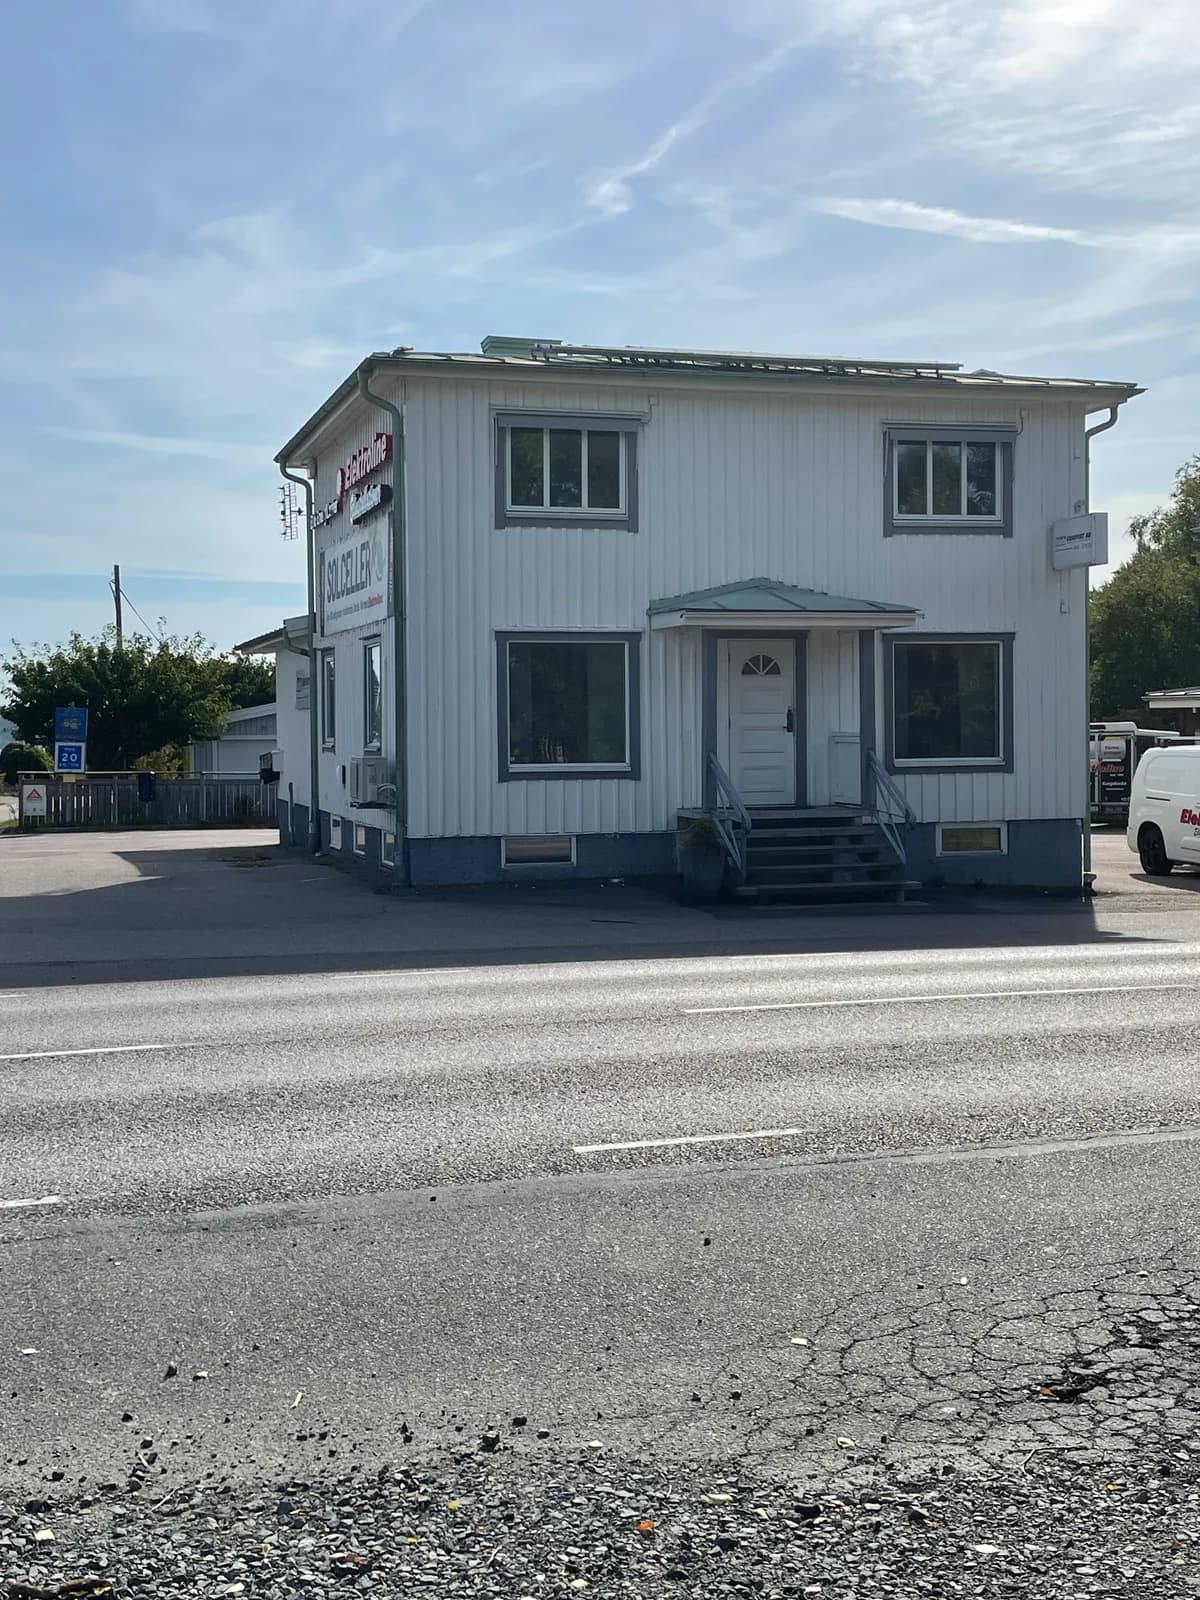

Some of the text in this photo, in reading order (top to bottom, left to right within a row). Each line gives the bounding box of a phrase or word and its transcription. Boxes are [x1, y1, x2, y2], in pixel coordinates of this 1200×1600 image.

[343, 434, 387, 491] Elektroline
[327, 541, 372, 604] SOLCELLER
[61, 753, 78, 762] 20
